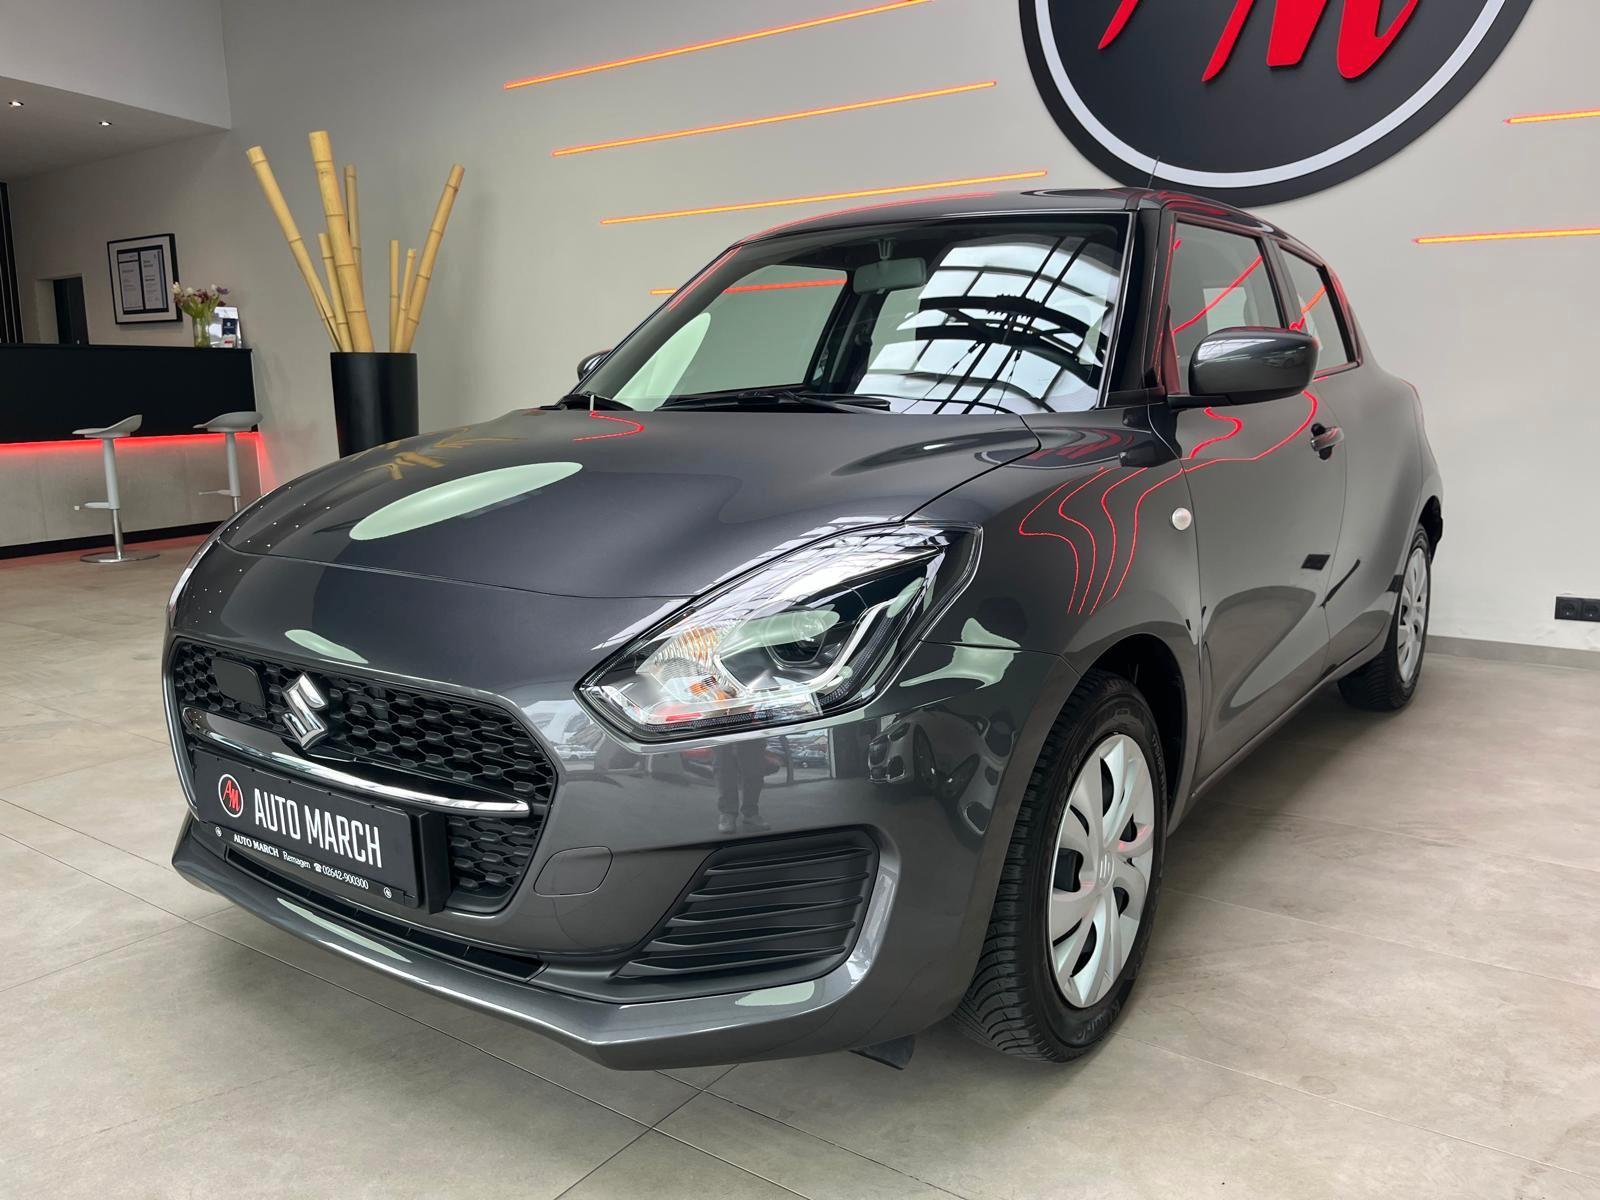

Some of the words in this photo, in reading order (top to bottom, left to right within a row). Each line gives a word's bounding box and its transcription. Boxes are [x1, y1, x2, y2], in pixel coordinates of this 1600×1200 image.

[233, 833, 253, 848] AUTO
[253, 839, 280, 859] MARCH
[282, 850, 312, 870] Remagen
[254, 788, 301, 840] AUTO
[303, 804, 383, 869] MARCH
